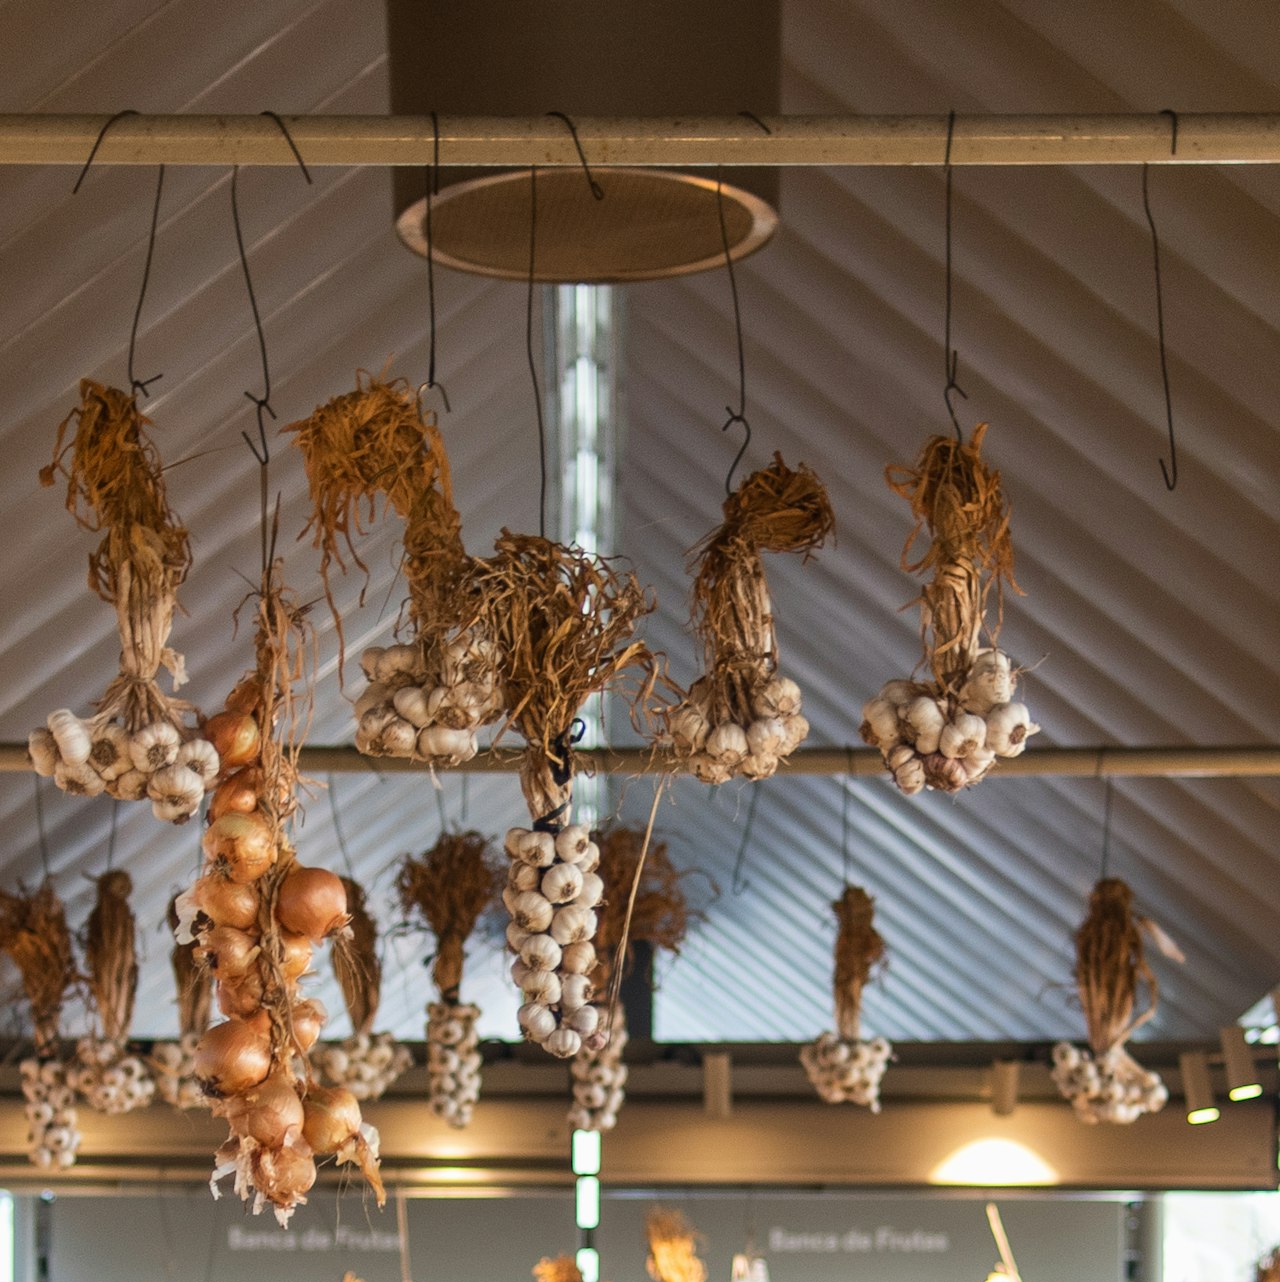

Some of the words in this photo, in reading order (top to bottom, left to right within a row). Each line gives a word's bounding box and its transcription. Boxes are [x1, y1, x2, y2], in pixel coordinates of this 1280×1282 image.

[228, 1225, 296, 1251] Banca
[301, 1226, 332, 1251] de
[769, 1226, 838, 1252] Banca
[843, 1228, 871, 1252] de
[875, 1225, 949, 1252] Frutas
